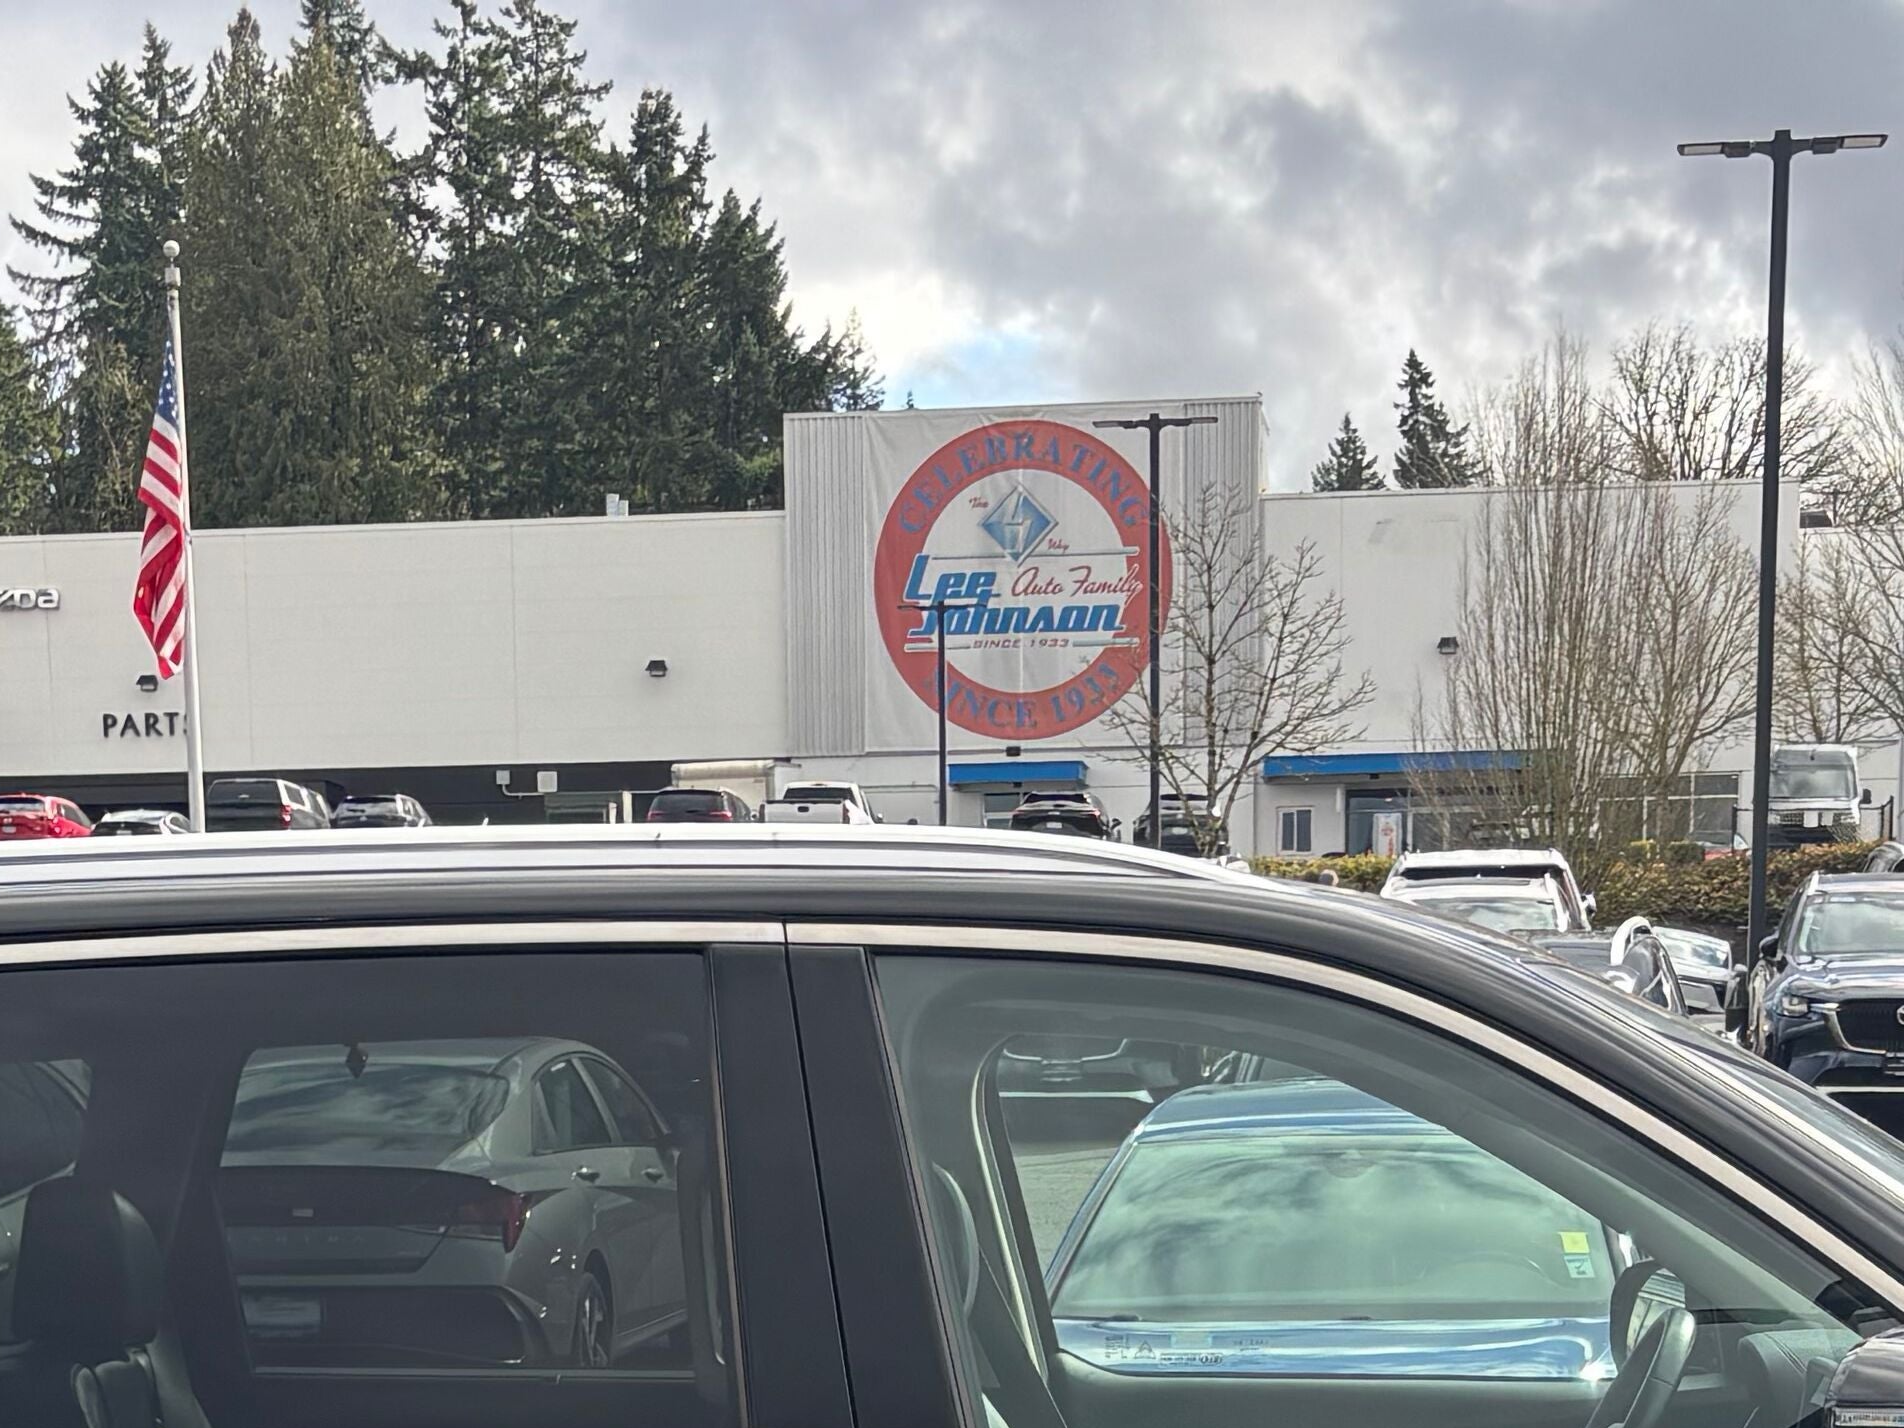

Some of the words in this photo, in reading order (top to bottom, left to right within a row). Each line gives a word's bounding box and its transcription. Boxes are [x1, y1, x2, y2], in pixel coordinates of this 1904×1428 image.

[899, 430, 1146, 534] CELEBRATING
[905, 554, 1001, 606] Lee
[1011, 567, 1063, 597] Auto
[1068, 564, 1143, 605] Family
[907, 604, 1125, 637] Johnson
[973, 639, 1020, 650] SINCE
[1030, 637, 1069, 648] 1933
[101, 711, 187, 738] PART
